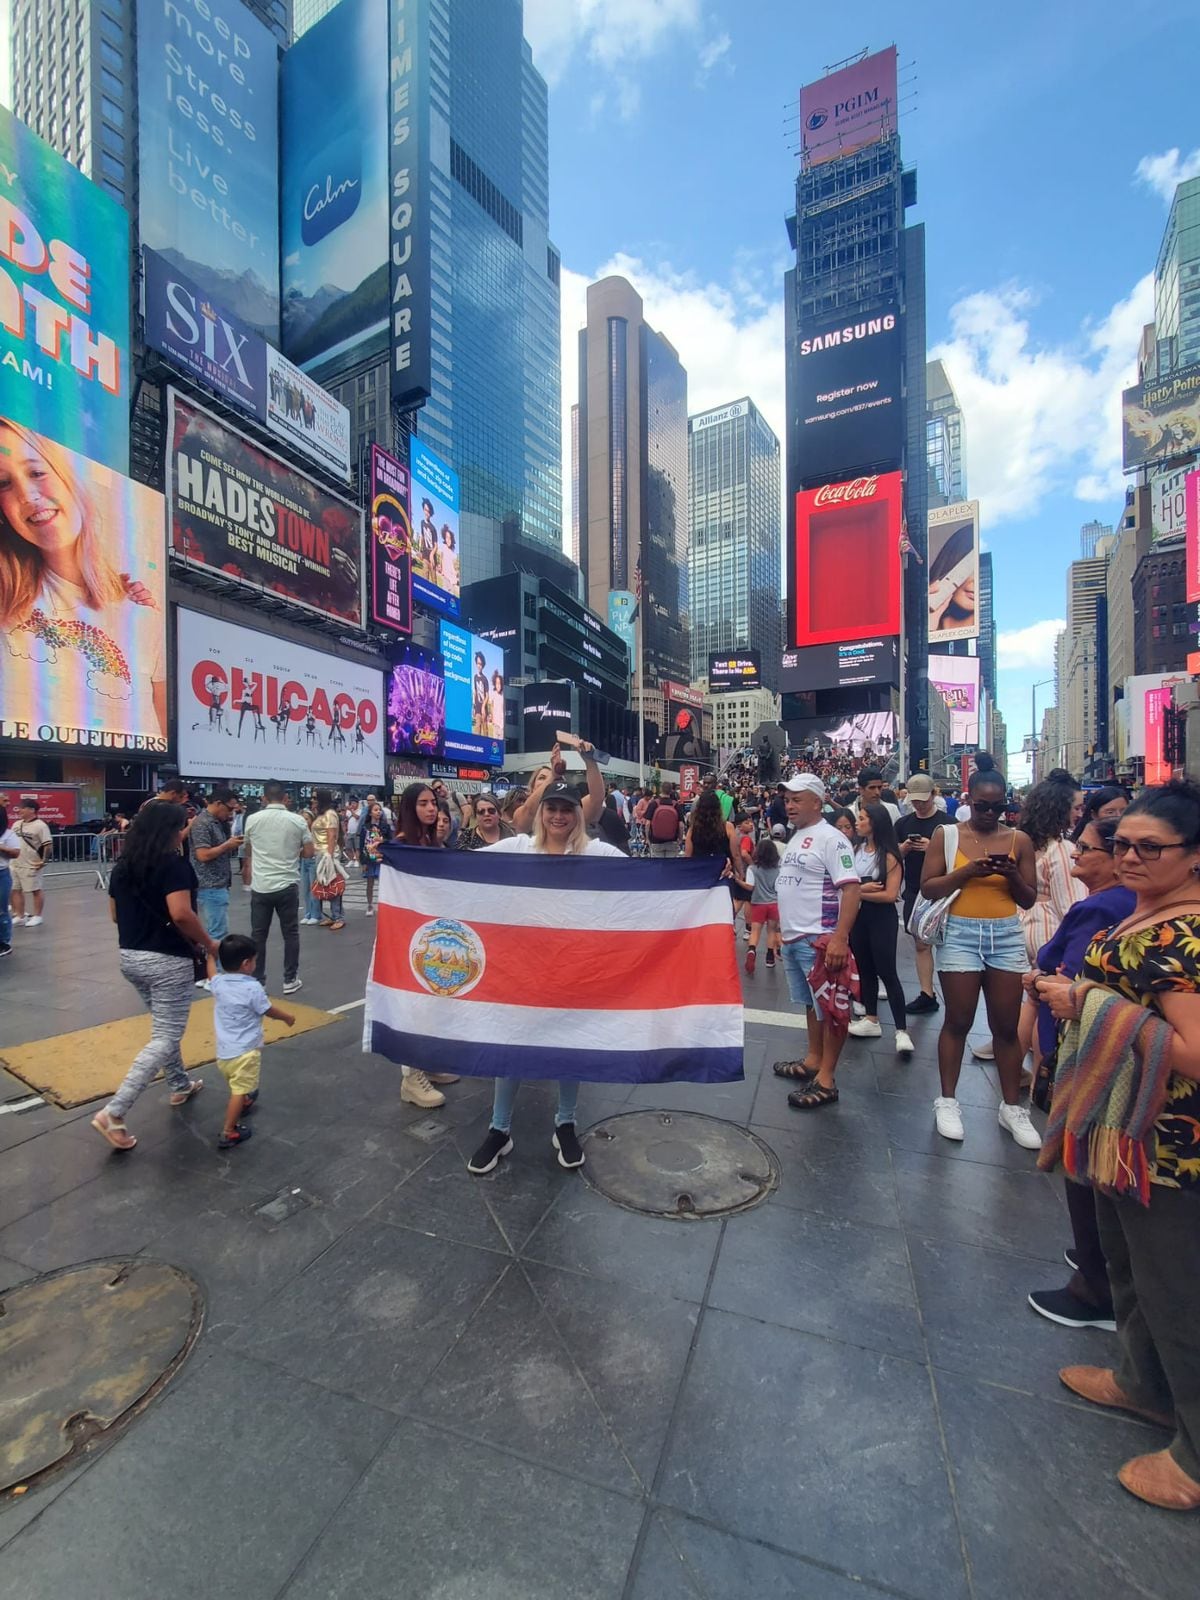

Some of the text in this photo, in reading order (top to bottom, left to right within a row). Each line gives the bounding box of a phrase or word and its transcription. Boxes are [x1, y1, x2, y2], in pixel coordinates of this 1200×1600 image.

[164, 0, 254, 95] more.
[194, 0, 251, 59] eep
[165, 43, 256, 142] Stress
[166, 74, 232, 154] less.
[833, 86, 880, 118] PGIM
[168, 126, 228, 196] Live
[303, 174, 359, 220] Calm
[390, 0, 413, 373] IMES SQUARE
[168, 160, 266, 257] better.
[0, 193, 91, 315] DE
[165, 281, 255, 391] SIX
[800, 313, 896, 356] SAMSUNG
[0, 348, 53, 391] AM!
[1144, 381, 1157, 389] ON
[816, 380, 878, 403] Register now
[1143, 375, 1200, 409] Harry Potte
[699, 410, 729, 427] Allianz
[201, 450, 223, 469] COME
[223, 461, 235, 476] SEE
[236, 468, 251, 483] HOW
[252, 478, 264, 492] THE
[265, 485, 285, 505] WORLD
[285, 496, 303, 514] COULD
[416, 468, 427, 480] and
[814, 474, 880, 507] Coca-Cola
[177, 452, 331, 567] HADESTOWN
[178, 498, 233, 531] BROADWAY'S
[234, 525, 254, 542] TONY
[256, 535, 271, 549] AND
[928, 503, 974, 521] OLAPLEX
[1161, 493, 1186, 530] HO
[227, 533, 300, 576] BEST MUSICAL
[442, 639, 449, 647] of
[443, 649, 451, 659] zip
[443, 660, 453, 669] and
[191, 659, 378, 735] CHICAGO
[0, 720, 168, 752] LE OUTFITTERS
[801, 836, 814, 850] S
[777, 875, 803, 887] ERTY
